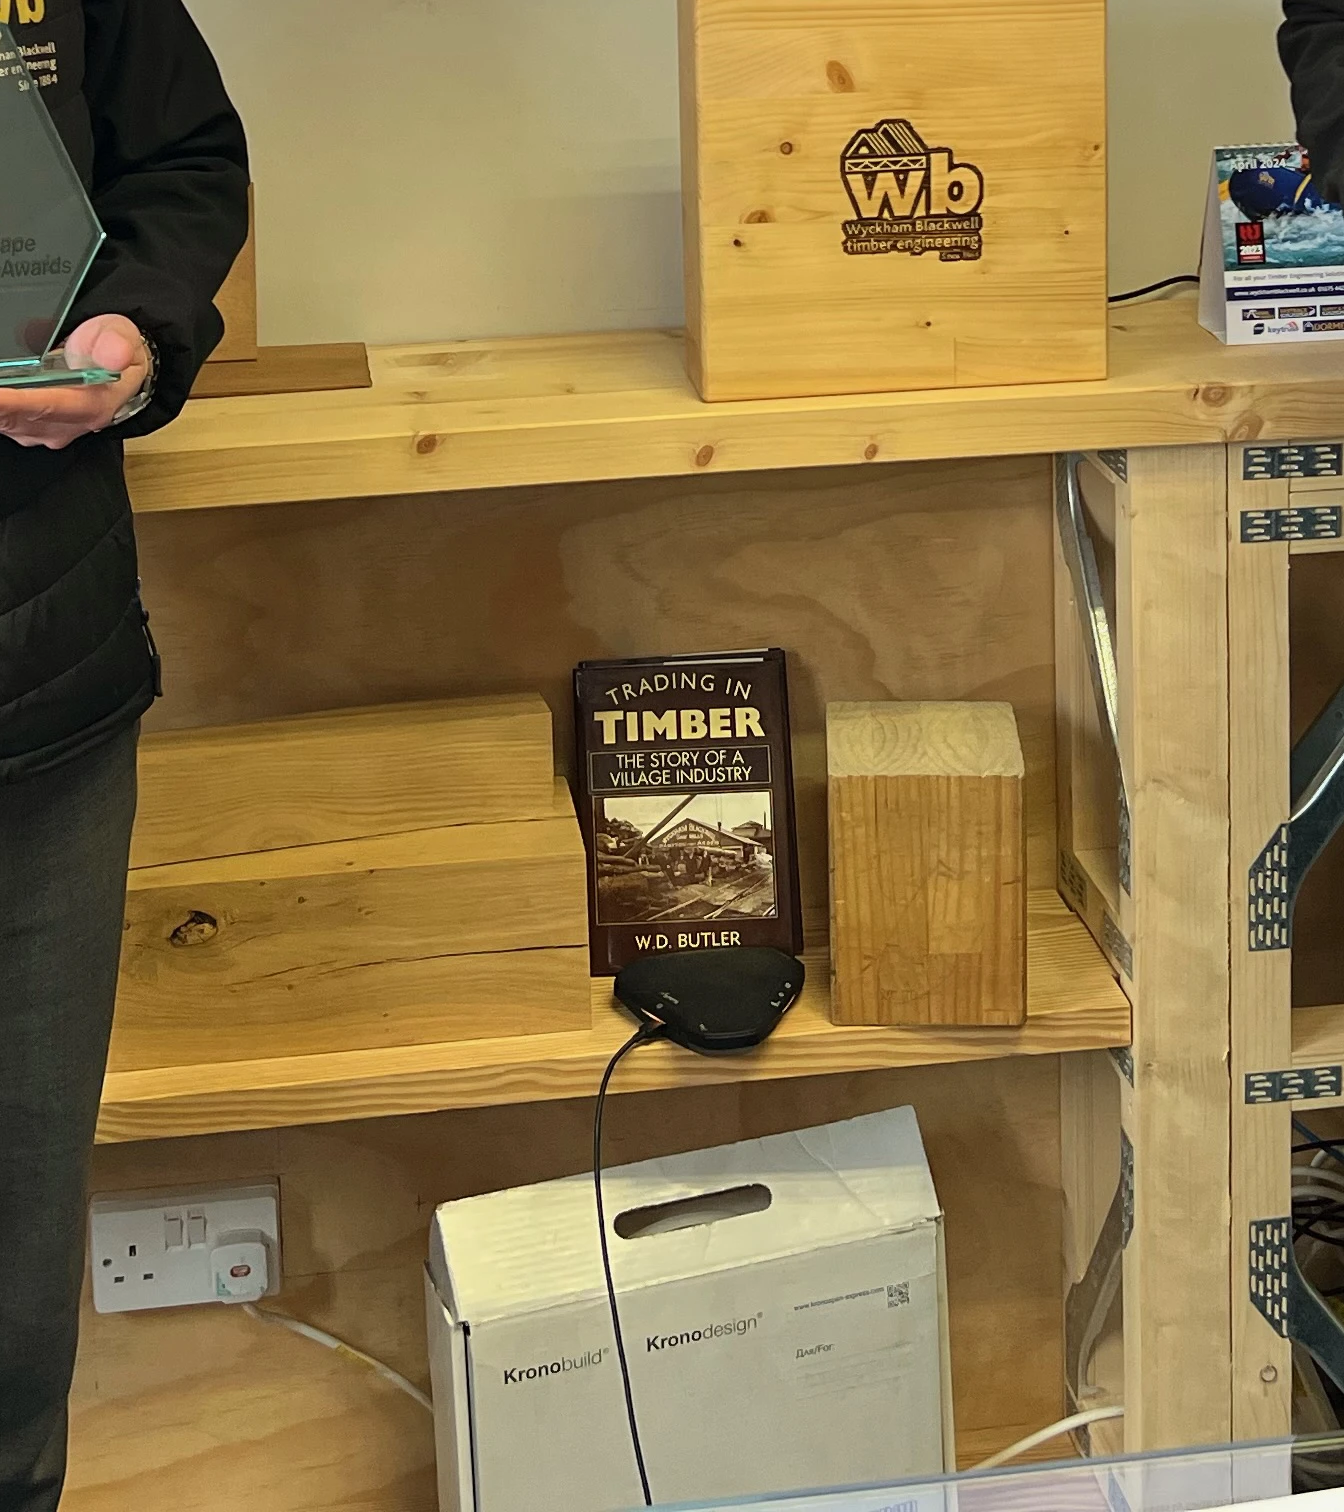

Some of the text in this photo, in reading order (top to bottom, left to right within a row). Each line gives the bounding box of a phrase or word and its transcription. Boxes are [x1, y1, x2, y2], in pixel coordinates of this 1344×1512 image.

[1230, 158, 1288, 173] April 2024
[844, 149, 982, 219] wb
[845, 216, 979, 237] Wyckham Blackwell
[846, 235, 979, 253] timber engineering
[0, 256, 72, 279] Awards
[605, 672, 752, 706] TRADING IN
[594, 706, 765, 746] TIMBER
[616, 750, 745, 769] THE STORY OF A
[609, 766, 753, 786] VILLAGE INDUSTRY
[635, 931, 741, 951] W.D. BUTLER
